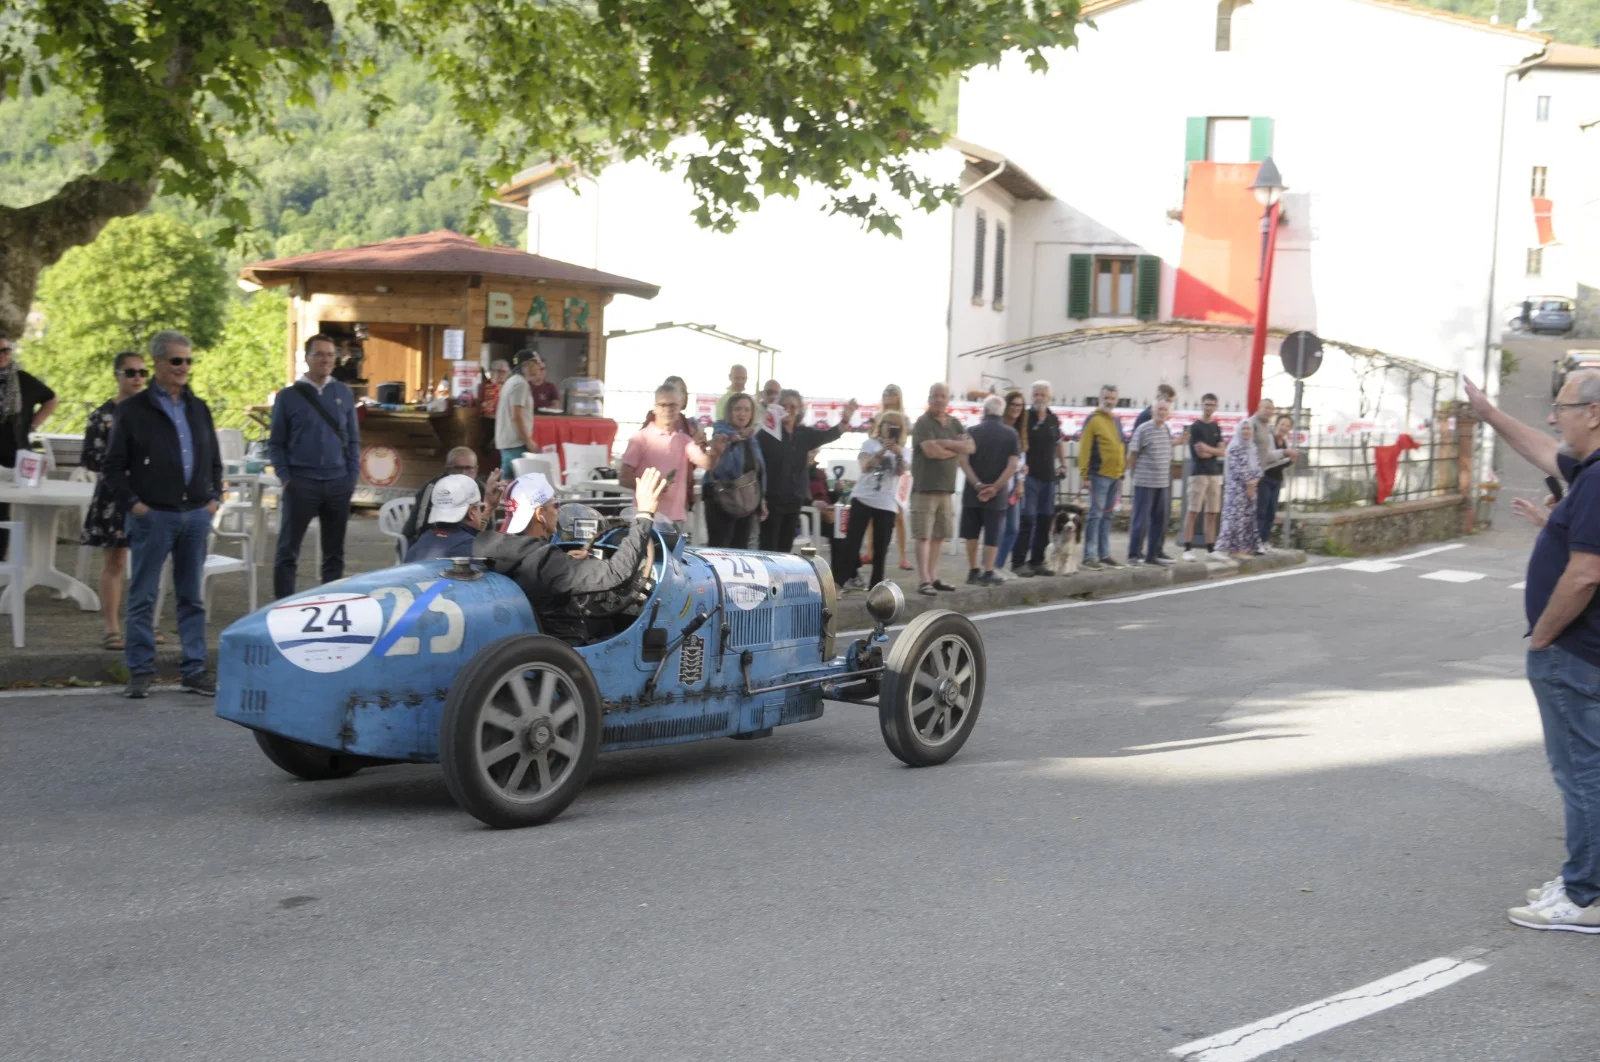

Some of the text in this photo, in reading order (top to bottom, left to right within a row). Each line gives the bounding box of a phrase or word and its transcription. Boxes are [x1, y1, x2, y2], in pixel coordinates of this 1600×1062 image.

[487, 291, 591, 332] BAR
[720, 556, 756, 580] 24
[300, 604, 352, 633] 24
